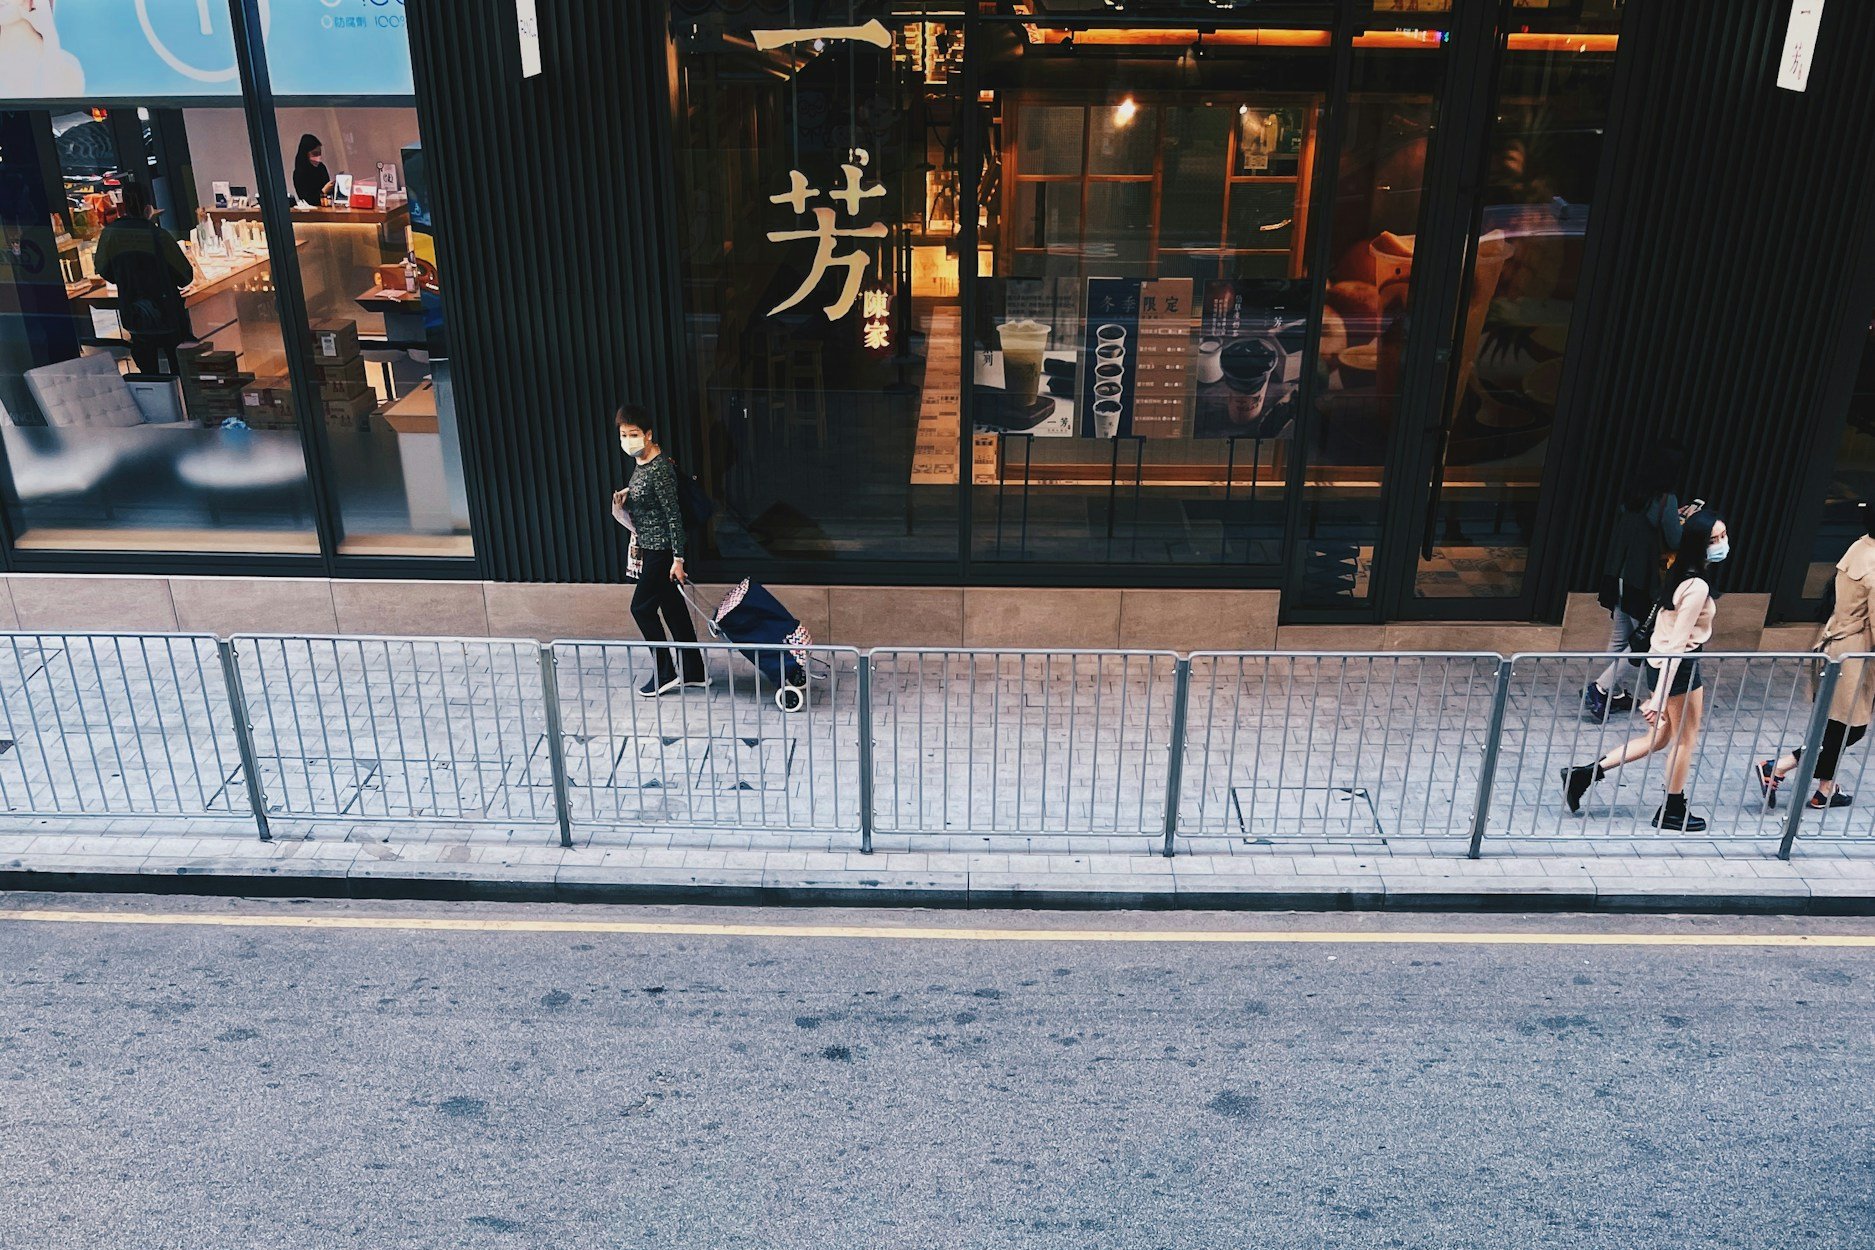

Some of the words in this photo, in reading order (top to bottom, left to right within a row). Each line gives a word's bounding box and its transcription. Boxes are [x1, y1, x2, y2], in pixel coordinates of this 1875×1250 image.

[751, 18, 892, 321] 一芳
[862, 290, 890, 349] 陳家
[1101, 295, 1179, 313] 冬季限定
